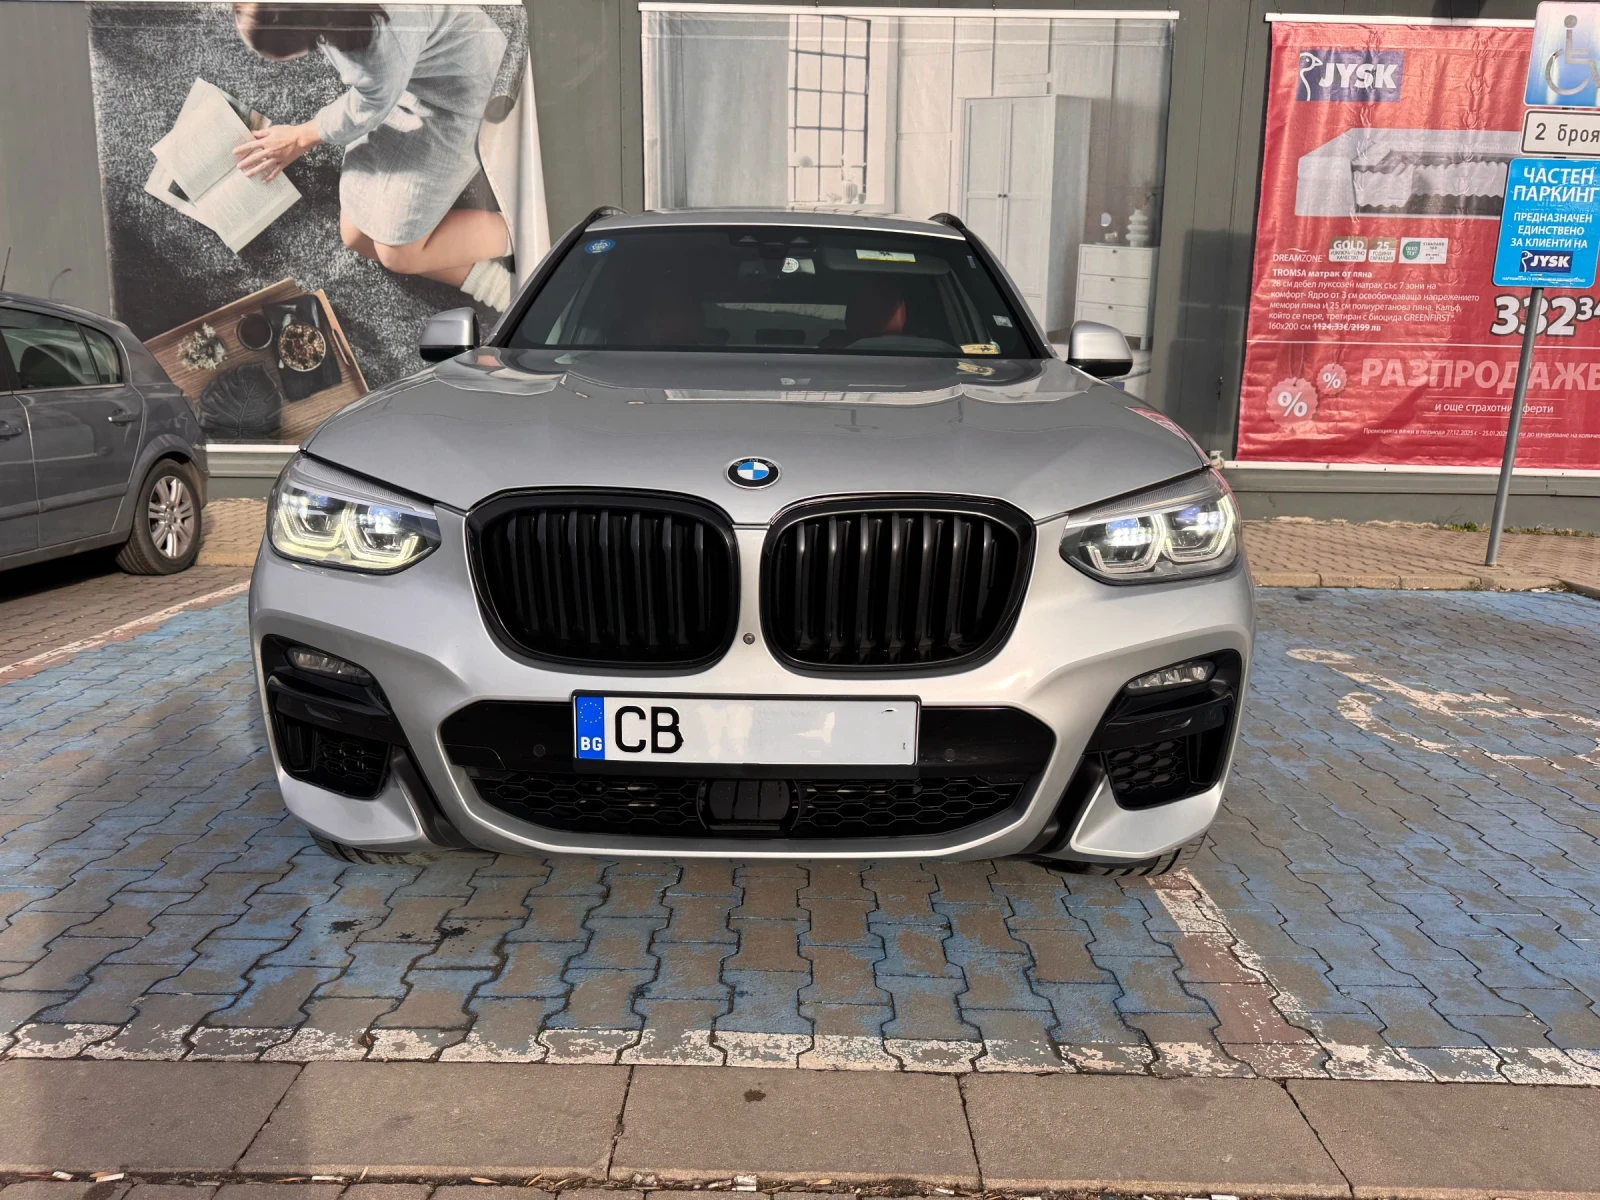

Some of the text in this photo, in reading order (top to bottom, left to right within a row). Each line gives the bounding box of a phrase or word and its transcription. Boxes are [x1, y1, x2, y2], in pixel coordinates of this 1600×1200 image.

[1318, 62, 1398, 89] JYSK
[1535, 122, 1600, 147] 2 броя
[1523, 167, 1595, 185] ЧАСТЕН
[1512, 185, 1600, 203] ПАРКИНГ
[1513, 212, 1593, 223] ПРЕДНАЗНАЧЕН
[1518, 225, 1585, 236] ЕДИНСТВЕНО
[1333, 240, 1365, 250] GOLD
[1377, 241, 1391, 250] 25
[1510, 237, 1588, 249] ЗА КЛИЕНТИ НА
[1530, 255, 1571, 268] JYSK
[1272, 268, 1373, 279] TROMSA матрак от пяна
[1293, 280, 1317, 289] дебел
[1317, 281, 1354, 290] луксозен
[1355, 282, 1383, 291] матрак
[1399, 281, 1405, 289] 7
[1307, 291, 1329, 300] Ядро
[1341, 291, 1347, 299] 3
[1358, 292, 1422, 300] освобождаваща
[1423, 294, 1480, 303] напрежението
[1269, 302, 1300, 310] мемори
[1329, 302, 1340, 310] 25
[1352, 304, 1411, 313] полиуретанова
[1268, 312, 1291, 320] който
[1326, 313, 1361, 322] третиран
[1368, 313, 1402, 322] биоцида
[1323, 372, 1342, 389] %
[1277, 391, 1308, 417] %
[1434, 403, 1442, 411] и
[1443, 403, 1464, 412] още
[580, 736, 603, 751] BG
